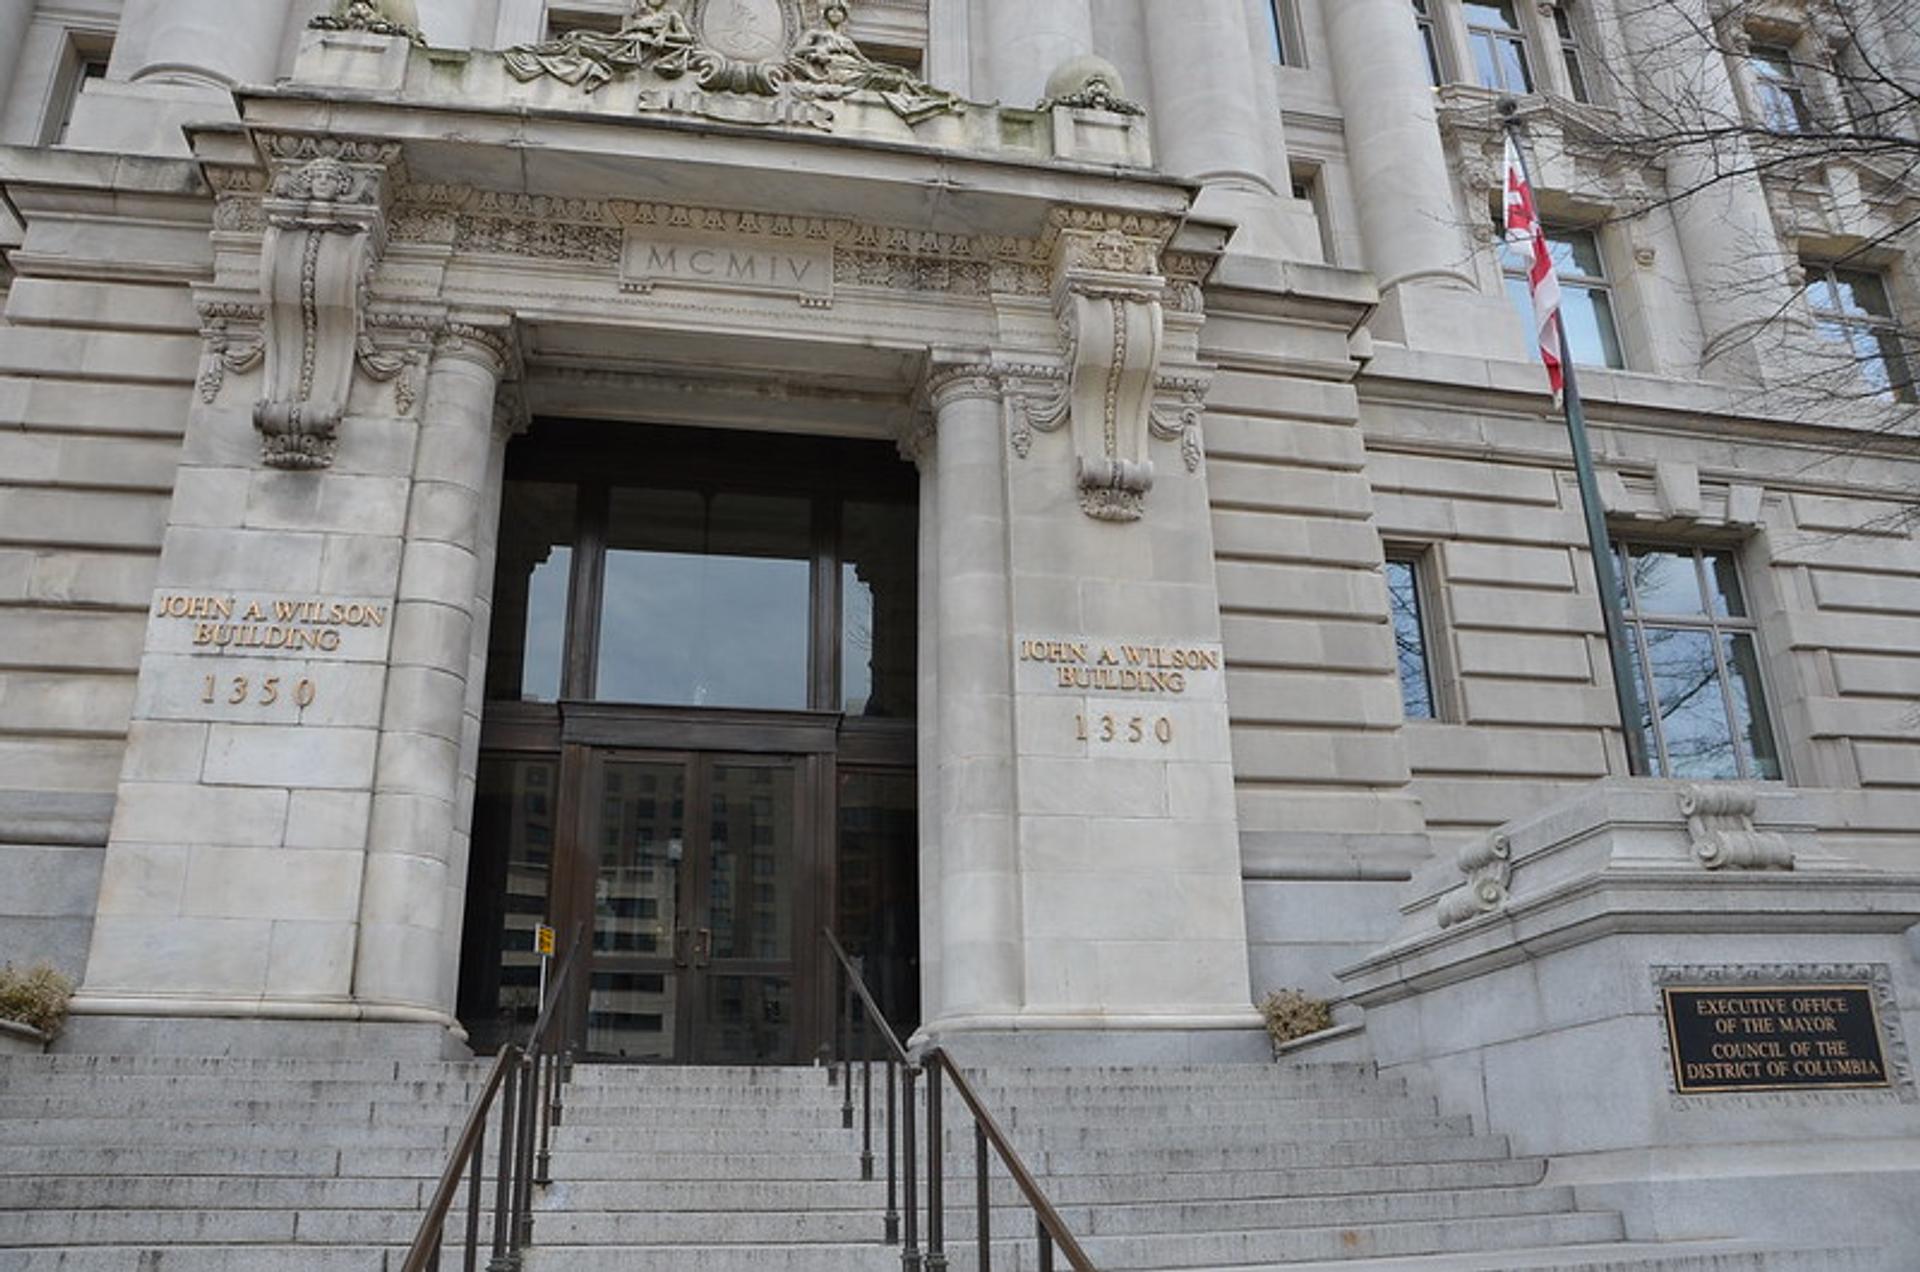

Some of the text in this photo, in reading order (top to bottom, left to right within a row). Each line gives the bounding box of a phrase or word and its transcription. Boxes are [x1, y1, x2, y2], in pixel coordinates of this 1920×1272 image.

[648, 246, 811, 282] MCMIV
[157, 595, 235, 620] JOHN
[273, 601, 388, 628] WILSON
[193, 624, 341, 652] BUILDING
[1020, 640, 1088, 664] JOHN
[1121, 645, 1220, 671] WILSON
[1057, 667, 1187, 693] BUILDING
[1696, 997, 1848, 1016] EXECUTIVE OFFICE
[1715, 1017, 1838, 1034] OF THE MAYOR
[1711, 1040, 1848, 1059] COUNCIL OF THE
[1687, 1060, 1880, 1080] DISTRICT OF COLUMBIA
